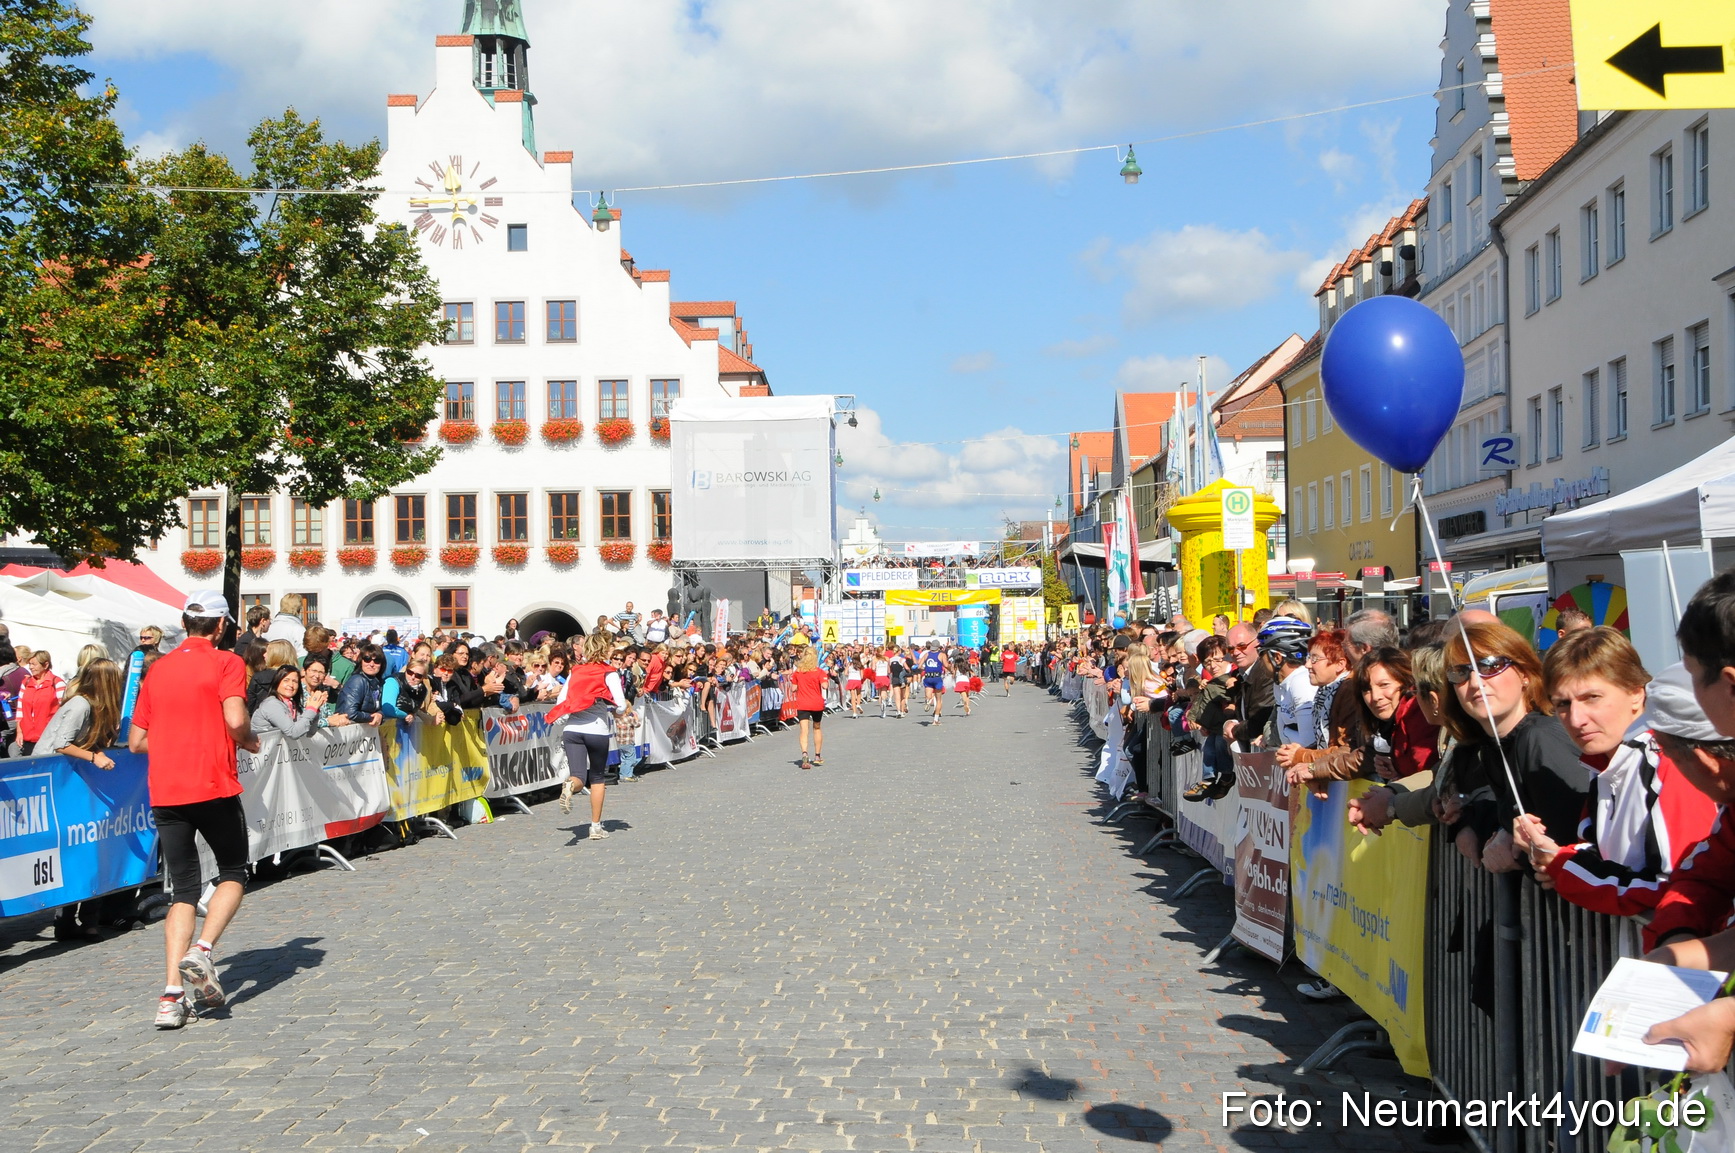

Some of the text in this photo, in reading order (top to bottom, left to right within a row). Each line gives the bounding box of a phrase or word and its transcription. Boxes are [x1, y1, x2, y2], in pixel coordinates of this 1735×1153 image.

[716, 470, 812, 483] BAROWSKI AG
[861, 571, 914, 581] PFLEIDERER
[980, 571, 1031, 584] BOCK
[930, 592, 956, 602] ZIEL
[1066, 612, 1076, 624] A
[826, 626, 836, 638] A
[490, 746, 556, 792] HACKNER
[66, 803, 157, 847] maxi-dsl.de
[34, 855, 54, 886] dsl
